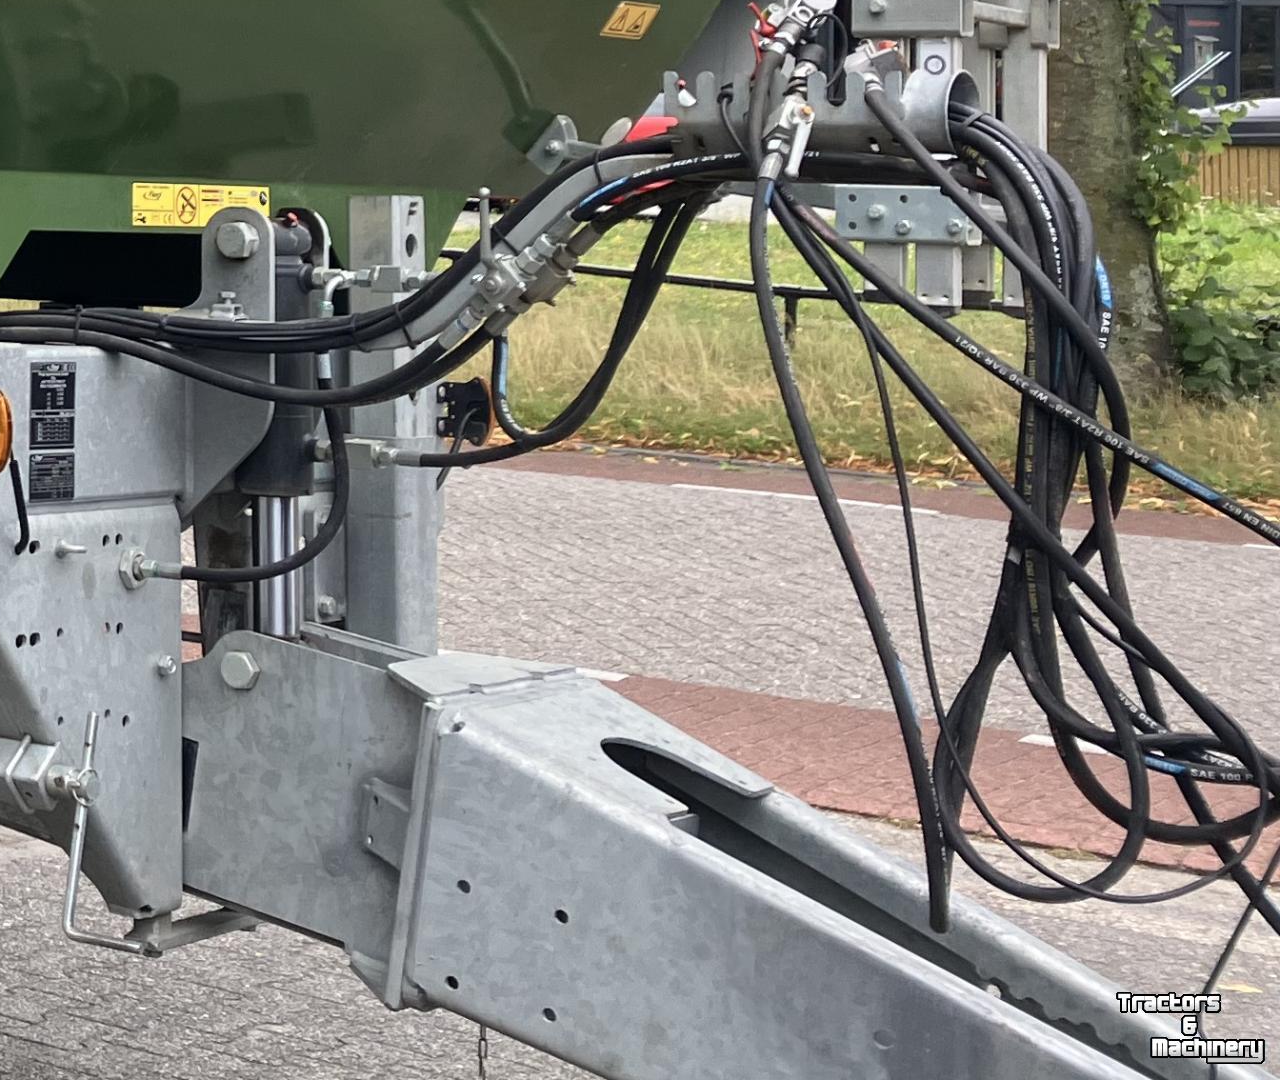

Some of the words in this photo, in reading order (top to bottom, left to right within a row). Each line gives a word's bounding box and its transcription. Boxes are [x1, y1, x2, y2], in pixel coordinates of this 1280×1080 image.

[1100, 311, 1112, 335] SAE
[1029, 386, 1049, 403] WP
[1125, 447, 1150, 466] SAE
[1241, 511, 1260, 527] EN
[1189, 767, 1216, 779] SAE
[1219, 771, 1241, 782] 100
